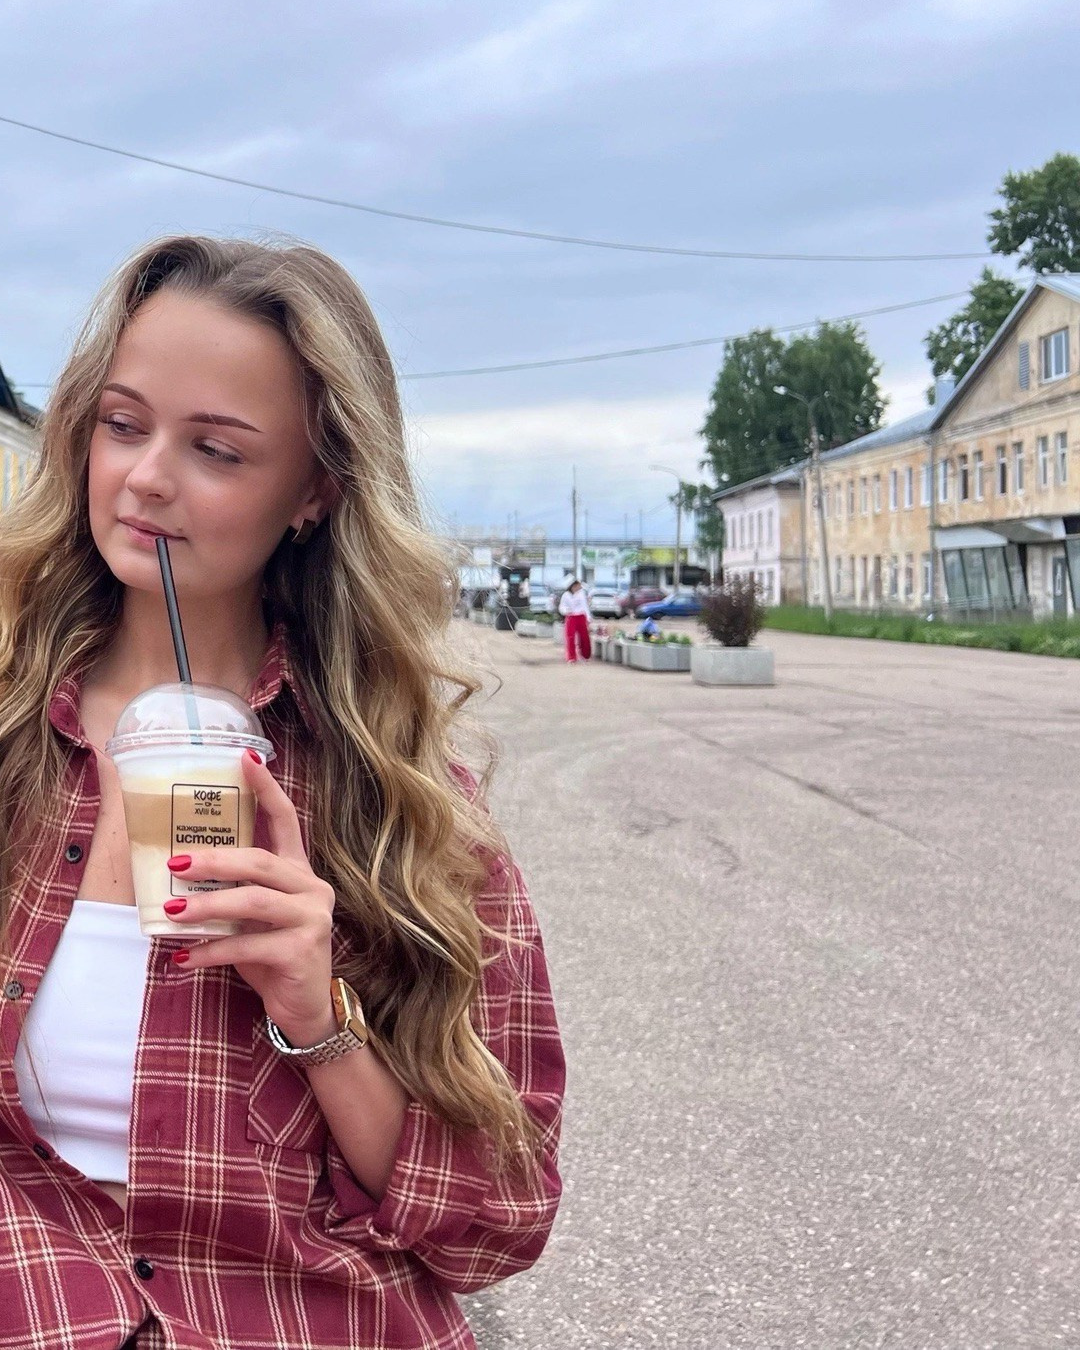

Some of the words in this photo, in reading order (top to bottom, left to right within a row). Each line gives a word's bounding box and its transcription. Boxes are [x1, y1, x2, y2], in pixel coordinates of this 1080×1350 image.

[193, 790, 222, 802] КОФЕ
[176, 825, 207, 833] каждая
[208, 826, 232, 834] чашка
[176, 834, 235, 847] история
